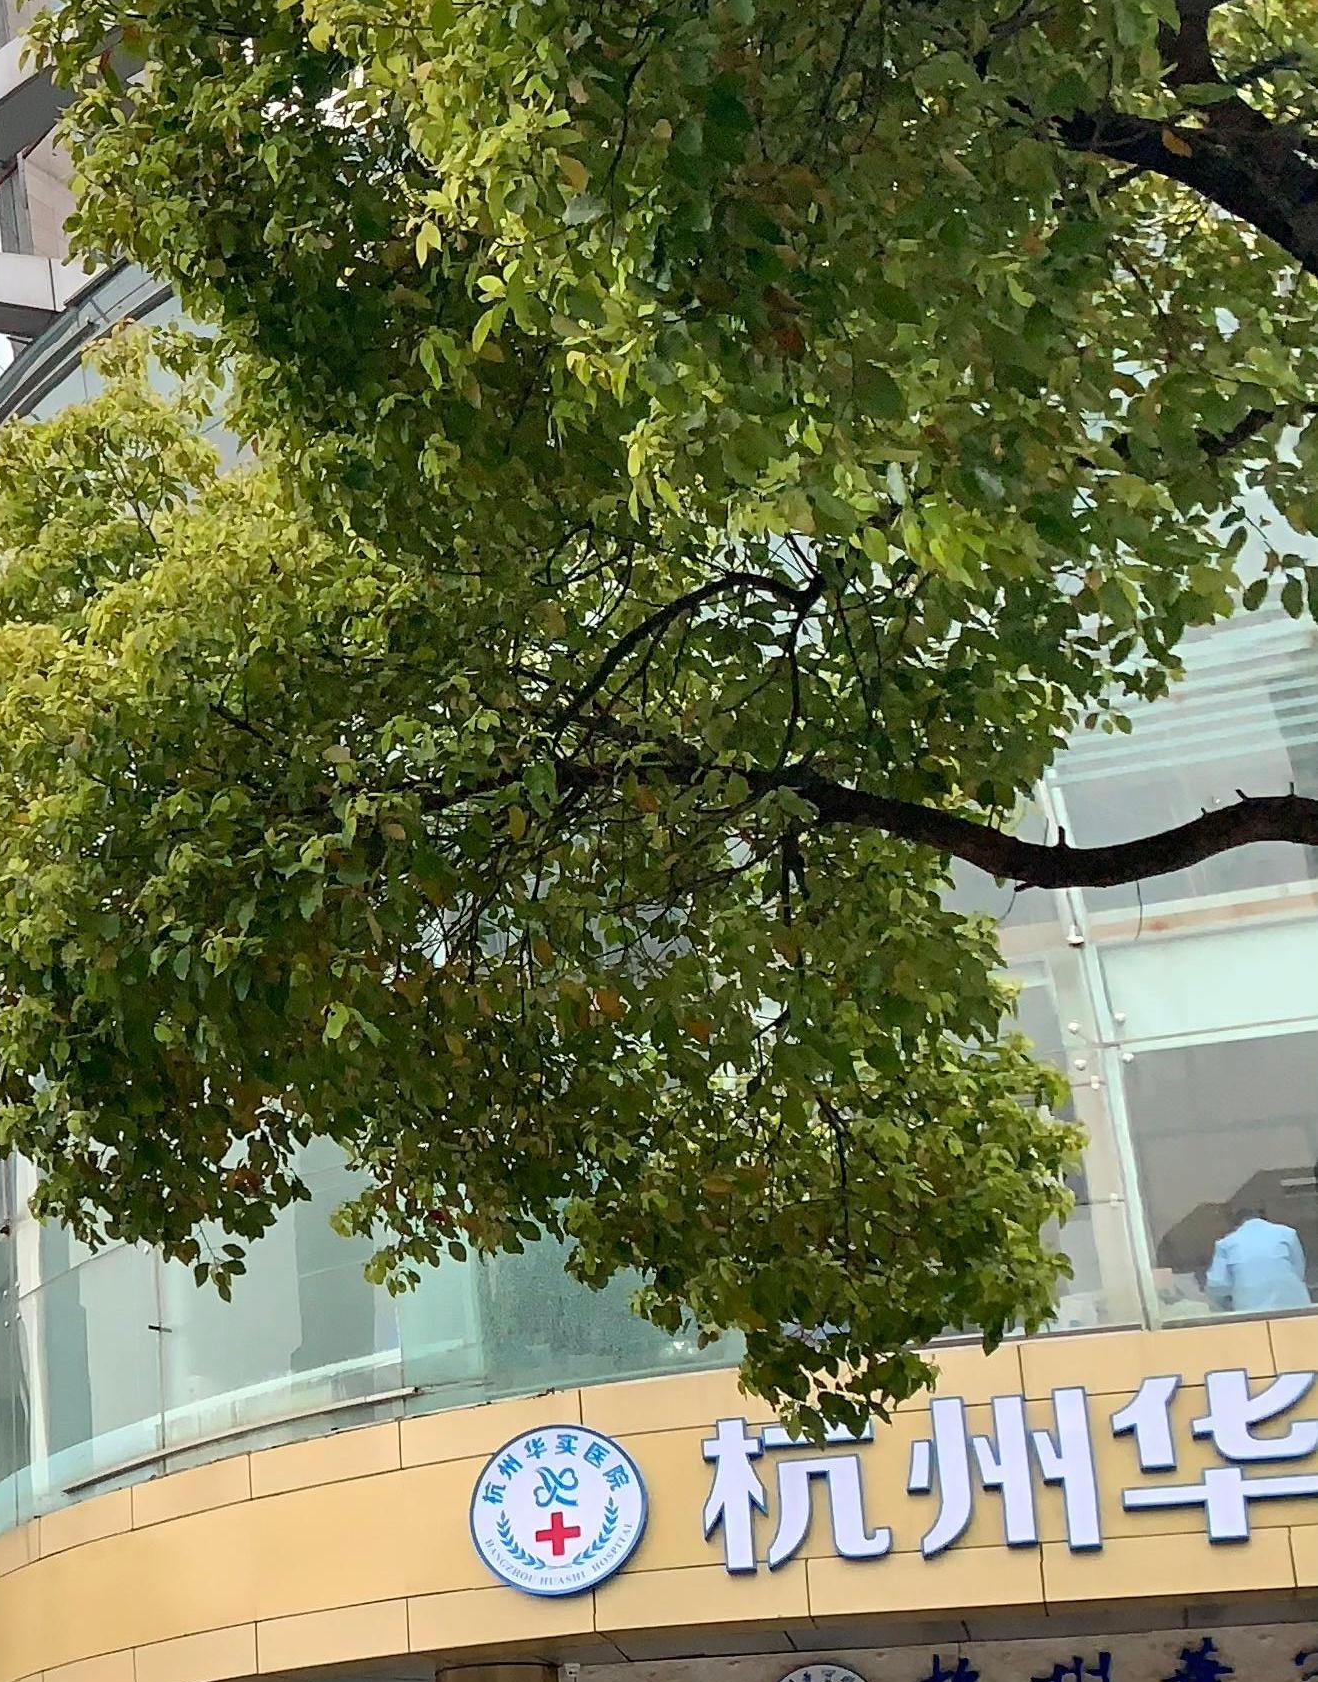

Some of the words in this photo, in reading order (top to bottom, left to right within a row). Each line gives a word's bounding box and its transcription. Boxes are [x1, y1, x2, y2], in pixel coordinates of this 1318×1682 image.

[482, 1434, 630, 1507] 杭州华实医院
[702, 1367, 1318, 1575] 杭州华
